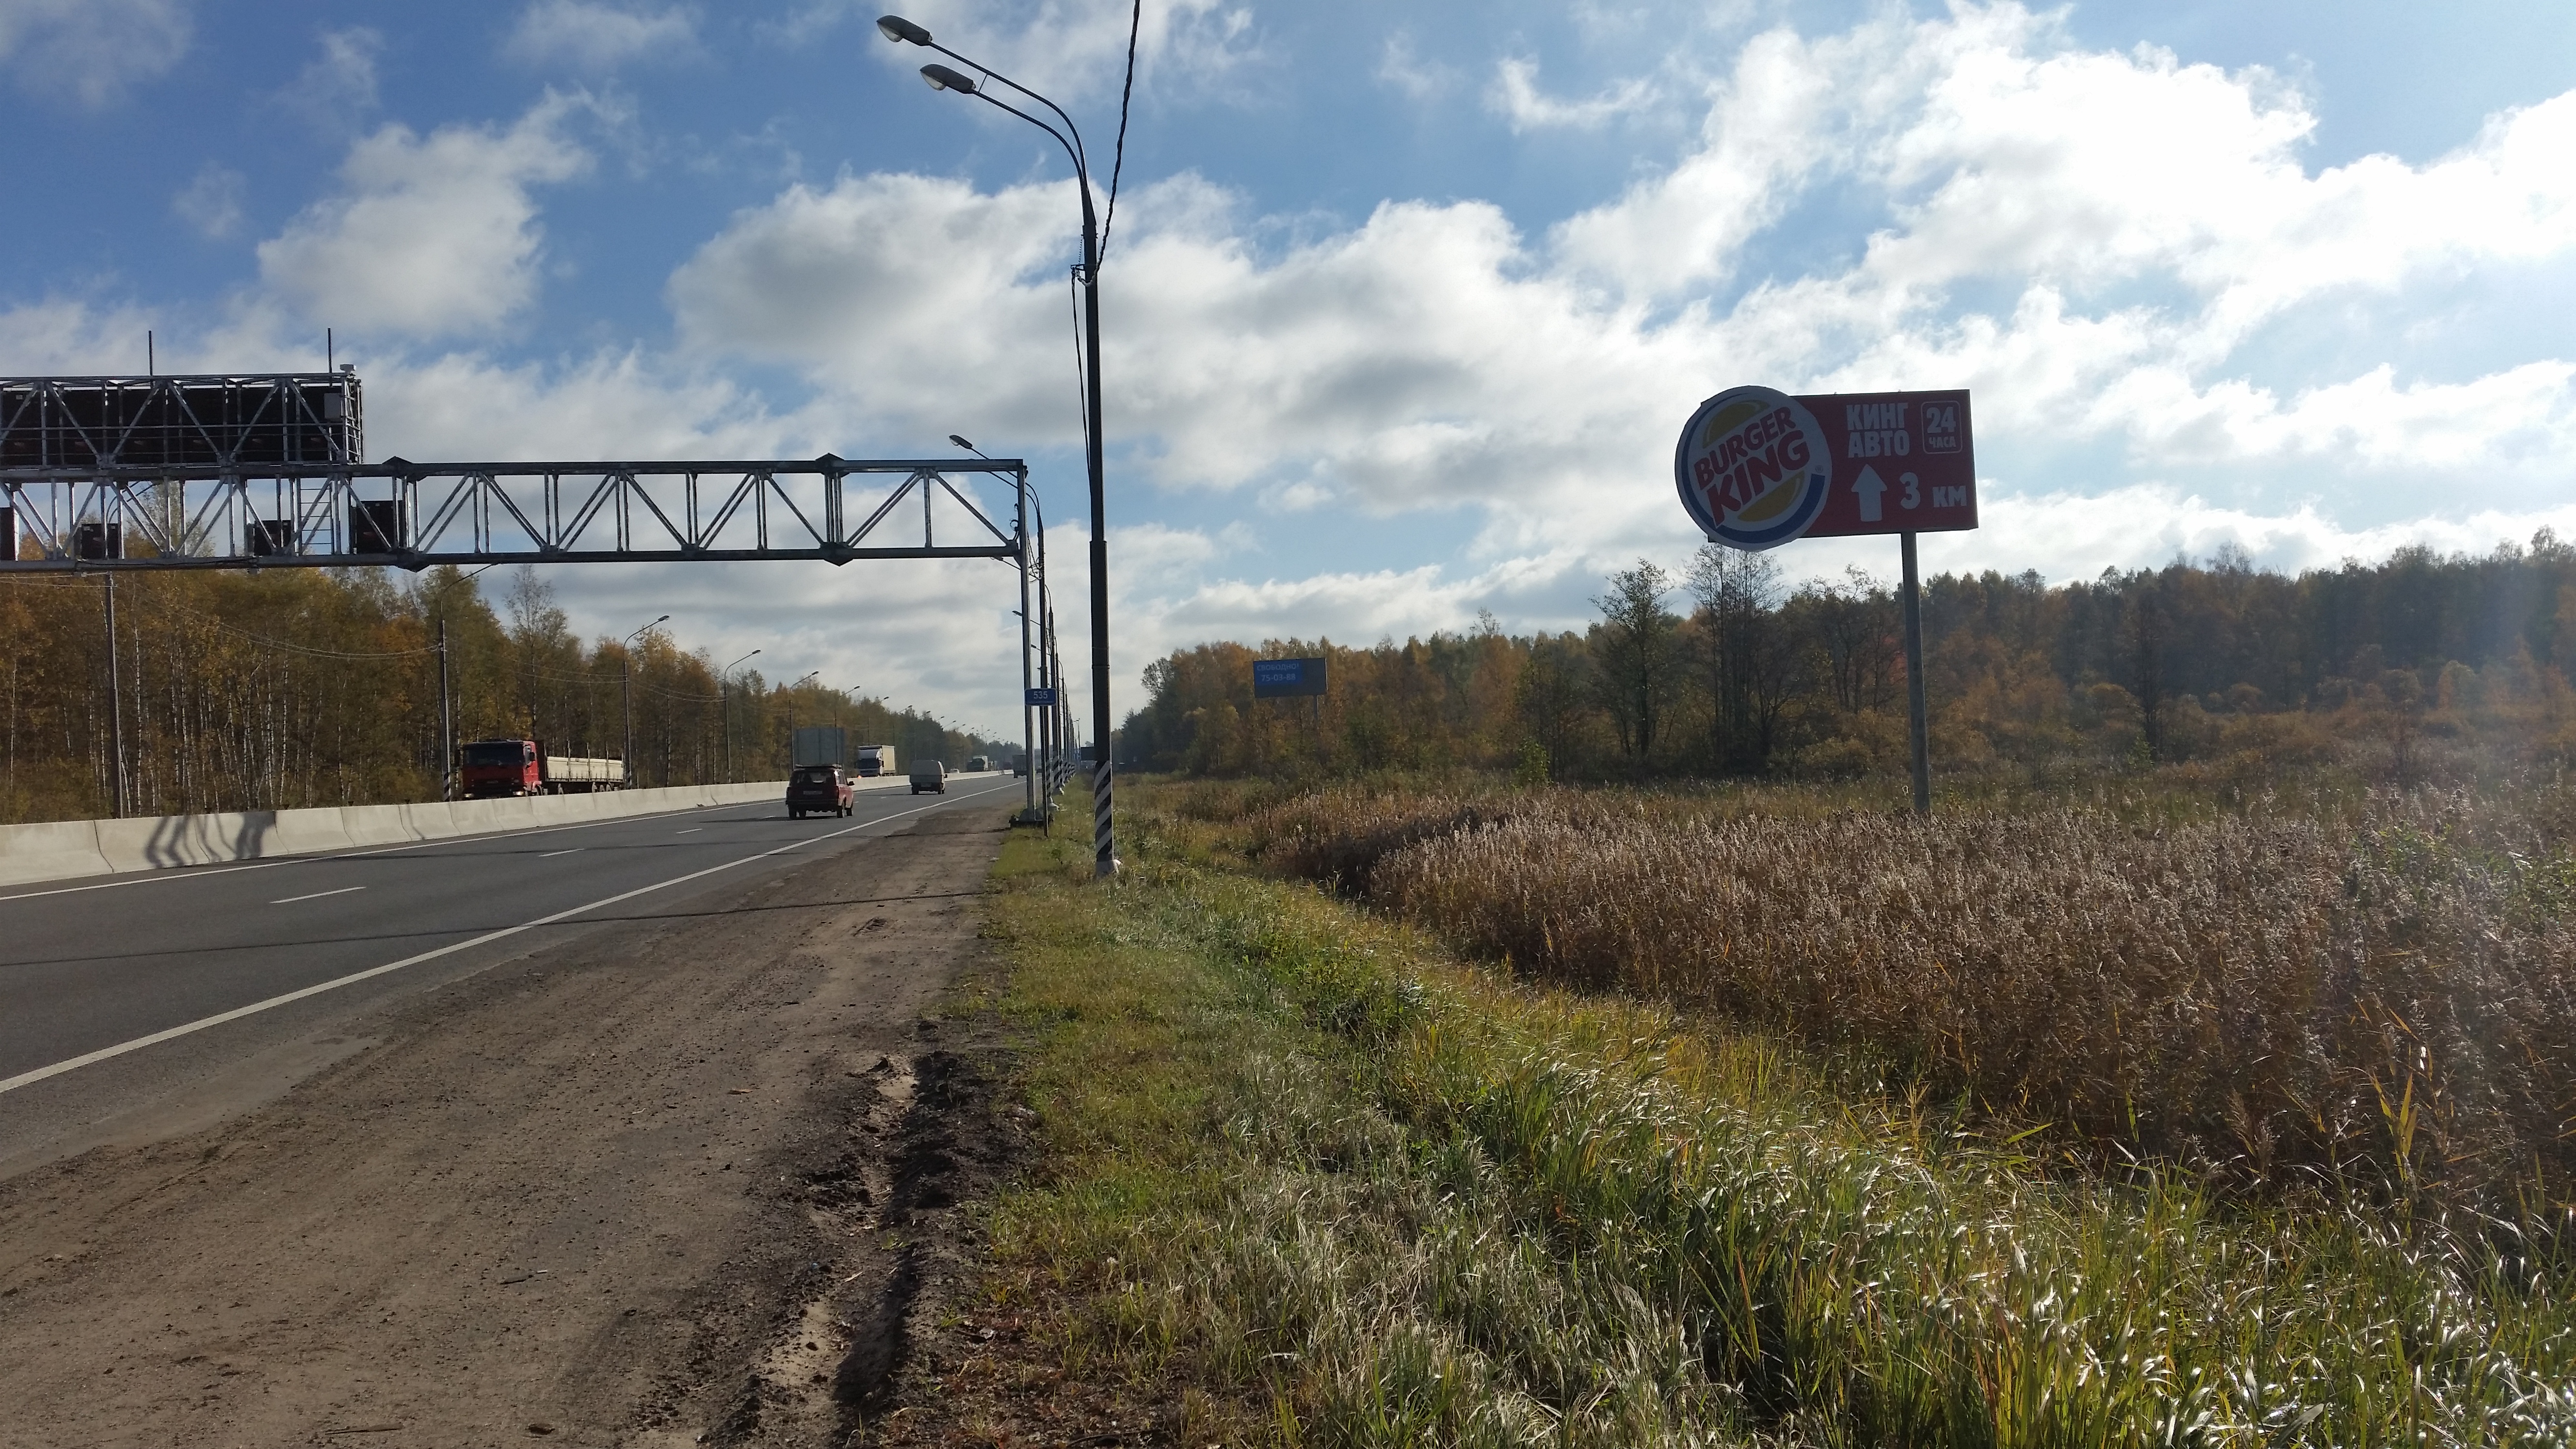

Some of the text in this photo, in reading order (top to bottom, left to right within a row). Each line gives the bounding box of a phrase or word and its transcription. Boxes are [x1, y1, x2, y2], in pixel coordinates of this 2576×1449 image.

[1846, 402, 1908, 430] КИНГ
[1927, 407, 1956, 433] 24
[1694, 407, 1796, 490] BURGER
[1848, 430, 1910, 458] АВТО
[1929, 436, 1956, 448] ЧАСА
[1707, 430, 1810, 529] KING
[1900, 472, 1921, 509] 3
[1033, 691, 1048, 699] 535
